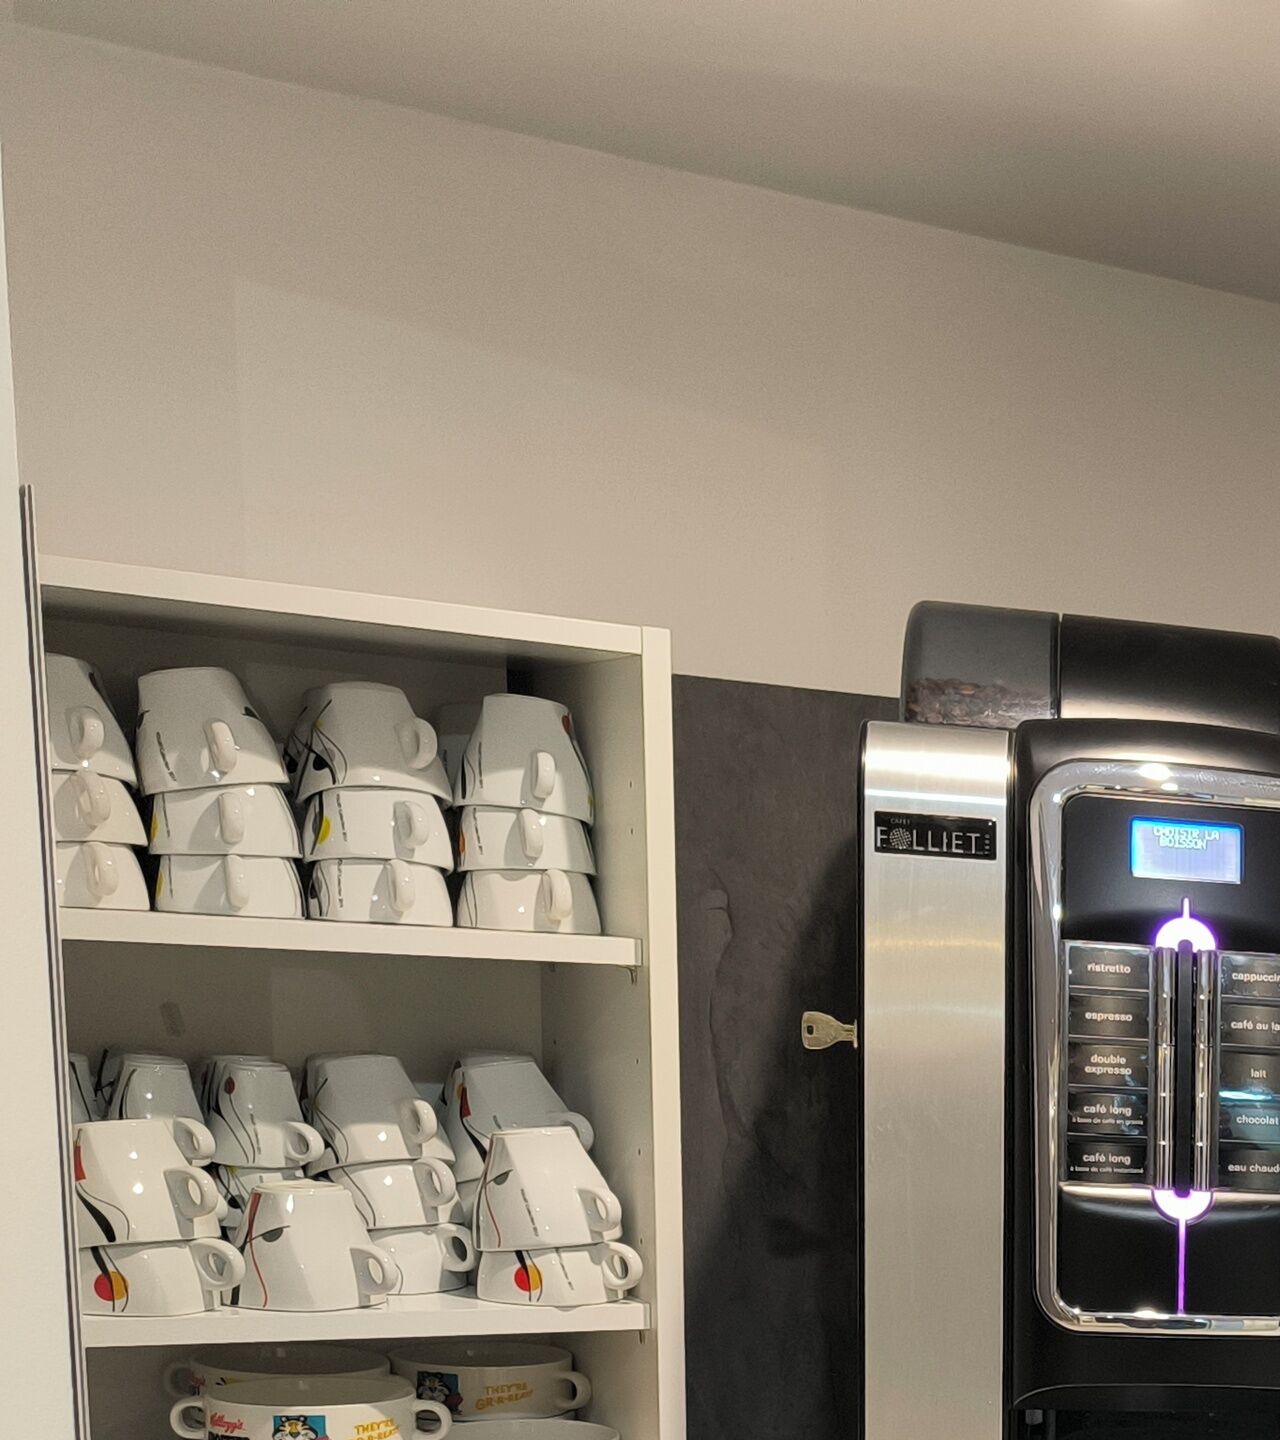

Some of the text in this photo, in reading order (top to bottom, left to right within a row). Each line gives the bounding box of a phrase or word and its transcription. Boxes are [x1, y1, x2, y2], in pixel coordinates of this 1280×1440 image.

[1204, 830, 1221, 841] LA
[1087, 962, 1132, 974] ristretto
[1084, 1011, 1133, 1023] espresso
[1230, 1020, 1254, 1030] café
[1256, 1022, 1269, 1031] au
[1090, 1053, 1127, 1065] double
[1250, 1068, 1267, 1079] lait
[1083, 1103, 1132, 1117] café long
[1236, 1114, 1280, 1126] chocolat
[1082, 1152, 1131, 1165] café long
[1227, 1163, 1247, 1172] eau
